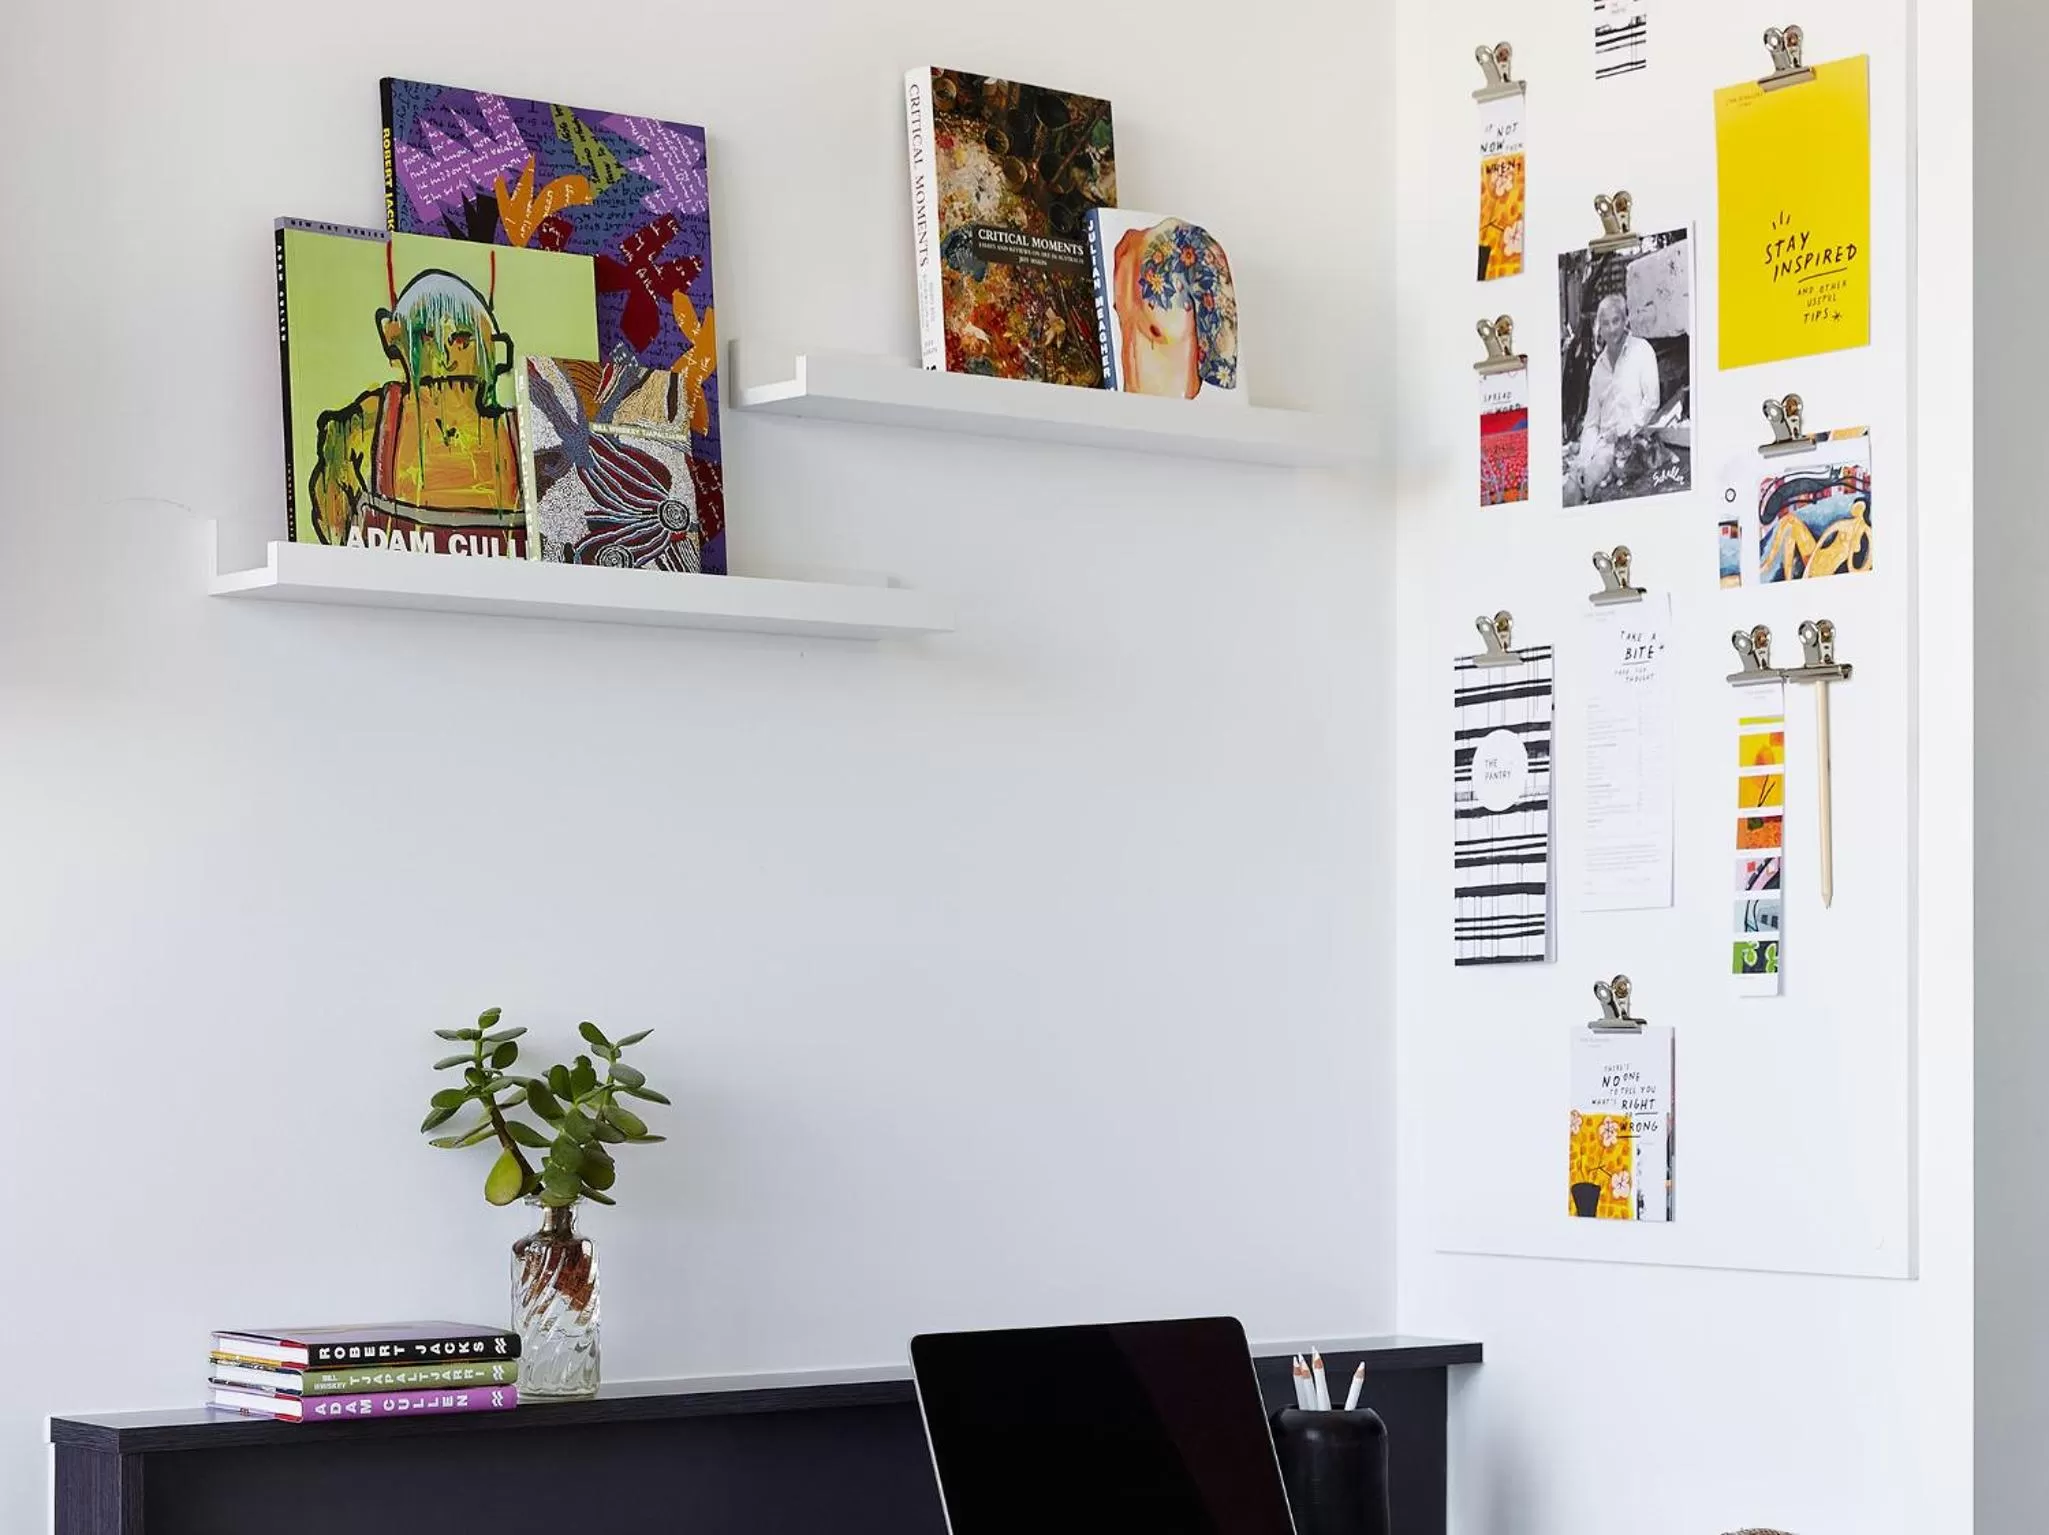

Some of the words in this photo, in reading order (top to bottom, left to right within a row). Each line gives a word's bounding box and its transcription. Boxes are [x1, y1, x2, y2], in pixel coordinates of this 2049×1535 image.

[908, 83, 924, 170] CRITICAL
[1497, 122, 1518, 137] NOT
[383, 127, 394, 188] ROBERT
[386, 192, 396, 233] JACK
[914, 175, 930, 268] MOMENTS
[978, 228, 1030, 247] CRITICAL
[1031, 236, 1084, 256] MOMENTS
[1764, 231, 1810, 265] STAY
[1773, 243, 1857, 283] INSPIRED
[1086, 219, 1102, 291] JULIAN
[1096, 295, 1112, 379] MEAGHER
[1798, 286, 1814, 296] AND
[1804, 308, 1829, 324] TIPS
[346, 525, 435, 555] ADAM
[448, 532, 531, 560] CULL
[1625, 644, 1655, 660] BITE
[1601, 1075, 1621, 1088] NO
[1623, 1072, 1640, 1082] ONE
[1641, 1085, 1657, 1094] YOU
[1621, 1099, 1656, 1110] RIGHT
[1620, 1120, 1659, 1133] WRONG
[319, 1344, 405, 1360] ROBERT
[415, 1341, 484, 1355] JACKS
[350, 1369, 485, 1386] TJAPALTJARRI
[315, 1399, 372, 1416] ADAM
[384, 1394, 468, 1411] CULLEN
